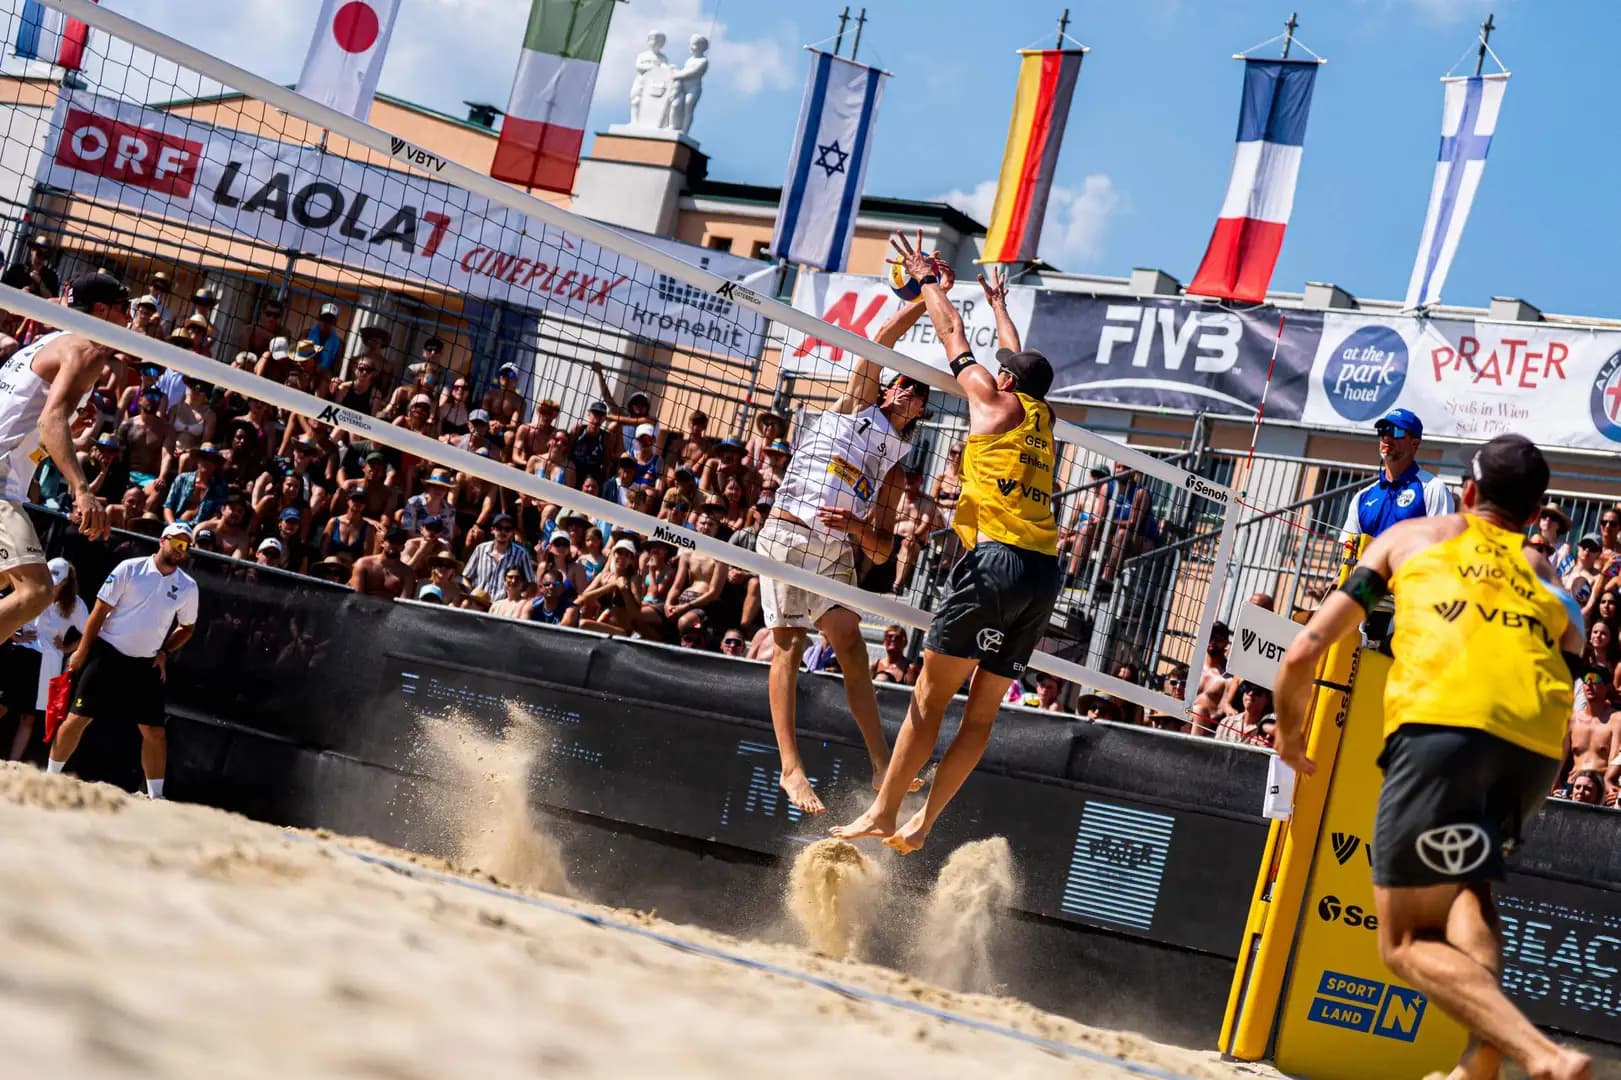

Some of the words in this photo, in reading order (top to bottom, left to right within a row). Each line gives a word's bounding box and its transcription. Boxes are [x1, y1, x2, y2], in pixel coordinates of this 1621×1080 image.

[71, 125, 191, 181] ORF
[407, 145, 447, 172] VBTV
[212, 160, 451, 258] LAOLA1
[460, 247, 629, 306] CINEPLEXX
[716, 281, 737, 301] AK
[632, 301, 743, 349] kronehit
[1095, 304, 1243, 374] FIVB
[1343, 347, 1360, 361] at
[1361, 345, 1385, 361] the
[1431, 335, 1569, 389] PRATER
[1333, 351, 1395, 394] park
[1344, 382, 1380, 402] hotel
[317, 405, 340, 426] AK
[1497, 402, 1529, 419] Wien
[1025, 434, 1048, 450] GER
[1021, 482, 1051, 507] VBT
[1195, 480, 1228, 503] Senoh
[1257, 637, 1286, 663] VBT
[1326, 977, 1377, 998] SPORT
[1320, 1005, 1363, 1026] LAND
